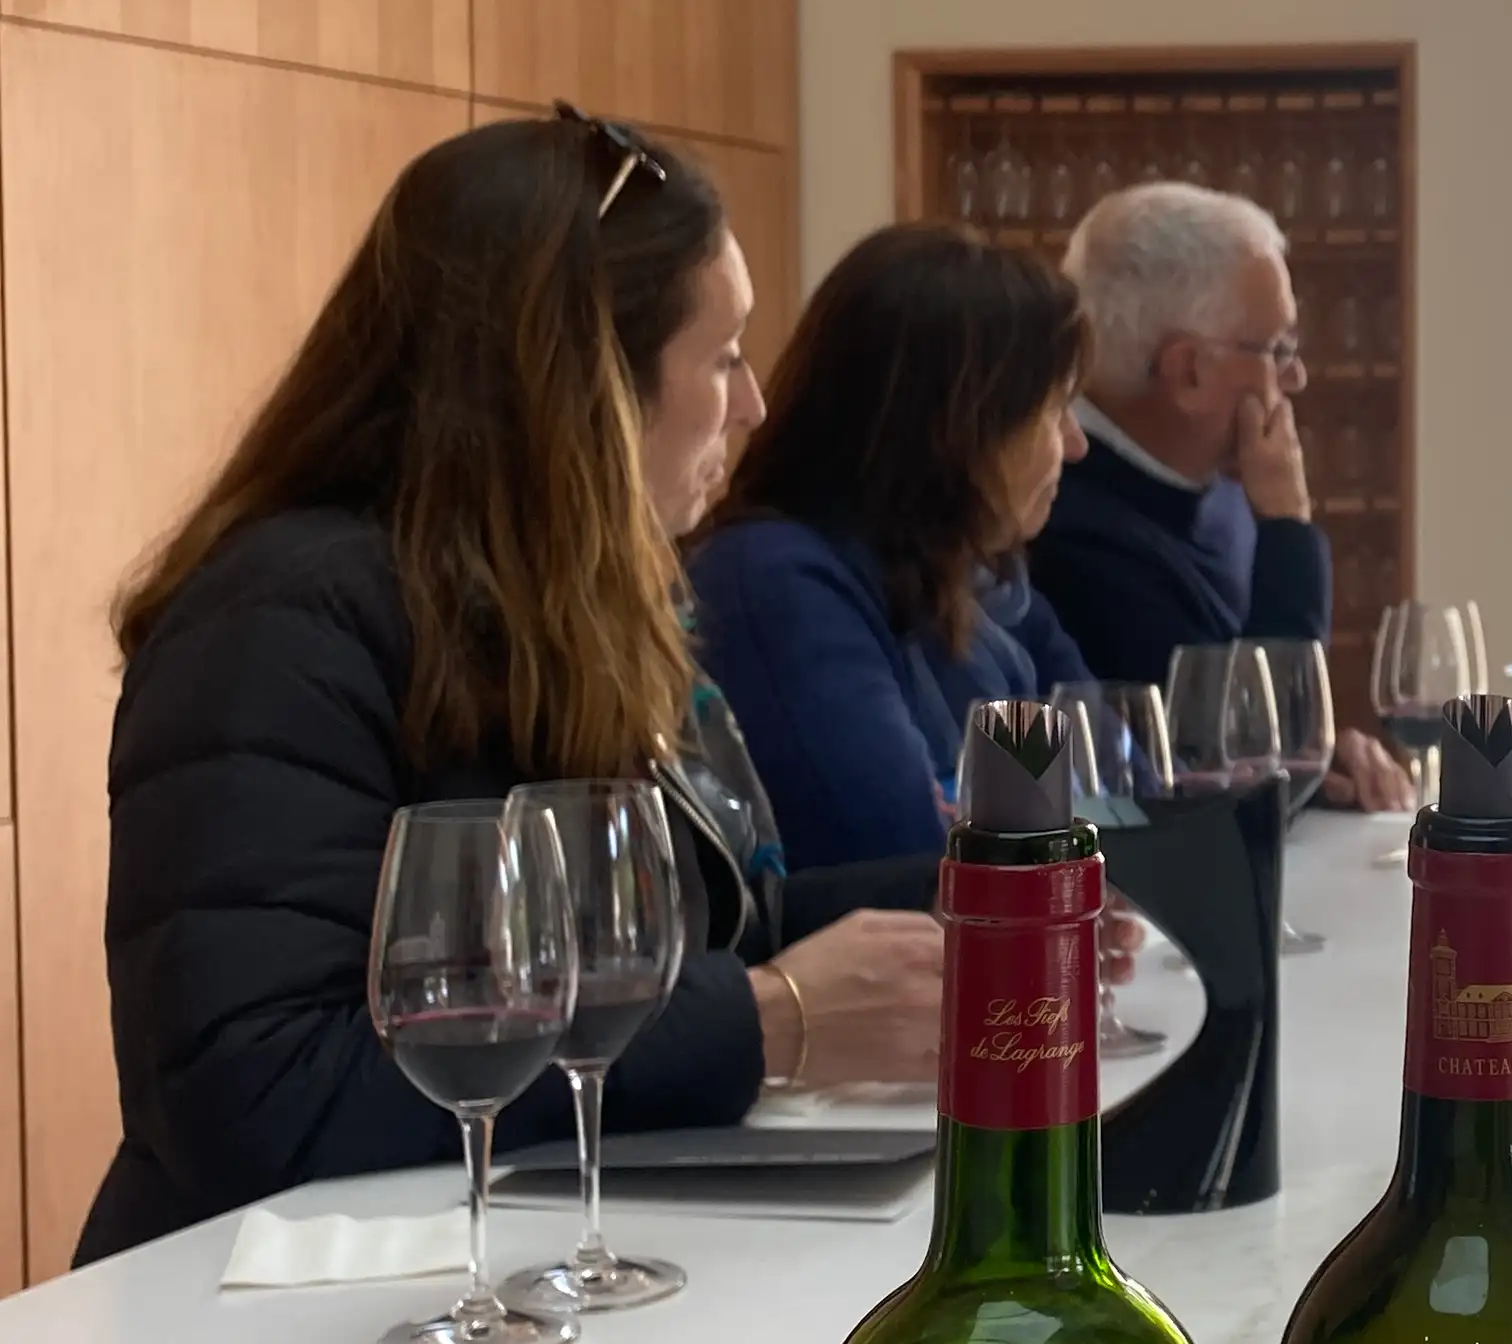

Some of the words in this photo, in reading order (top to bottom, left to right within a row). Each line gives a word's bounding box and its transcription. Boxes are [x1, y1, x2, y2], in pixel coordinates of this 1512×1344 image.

[983, 998, 1022, 1027] Les
[1024, 996, 1071, 1036] Fiefs
[970, 1037, 989, 1060] de
[989, 1032, 1085, 1074] Lagrange
